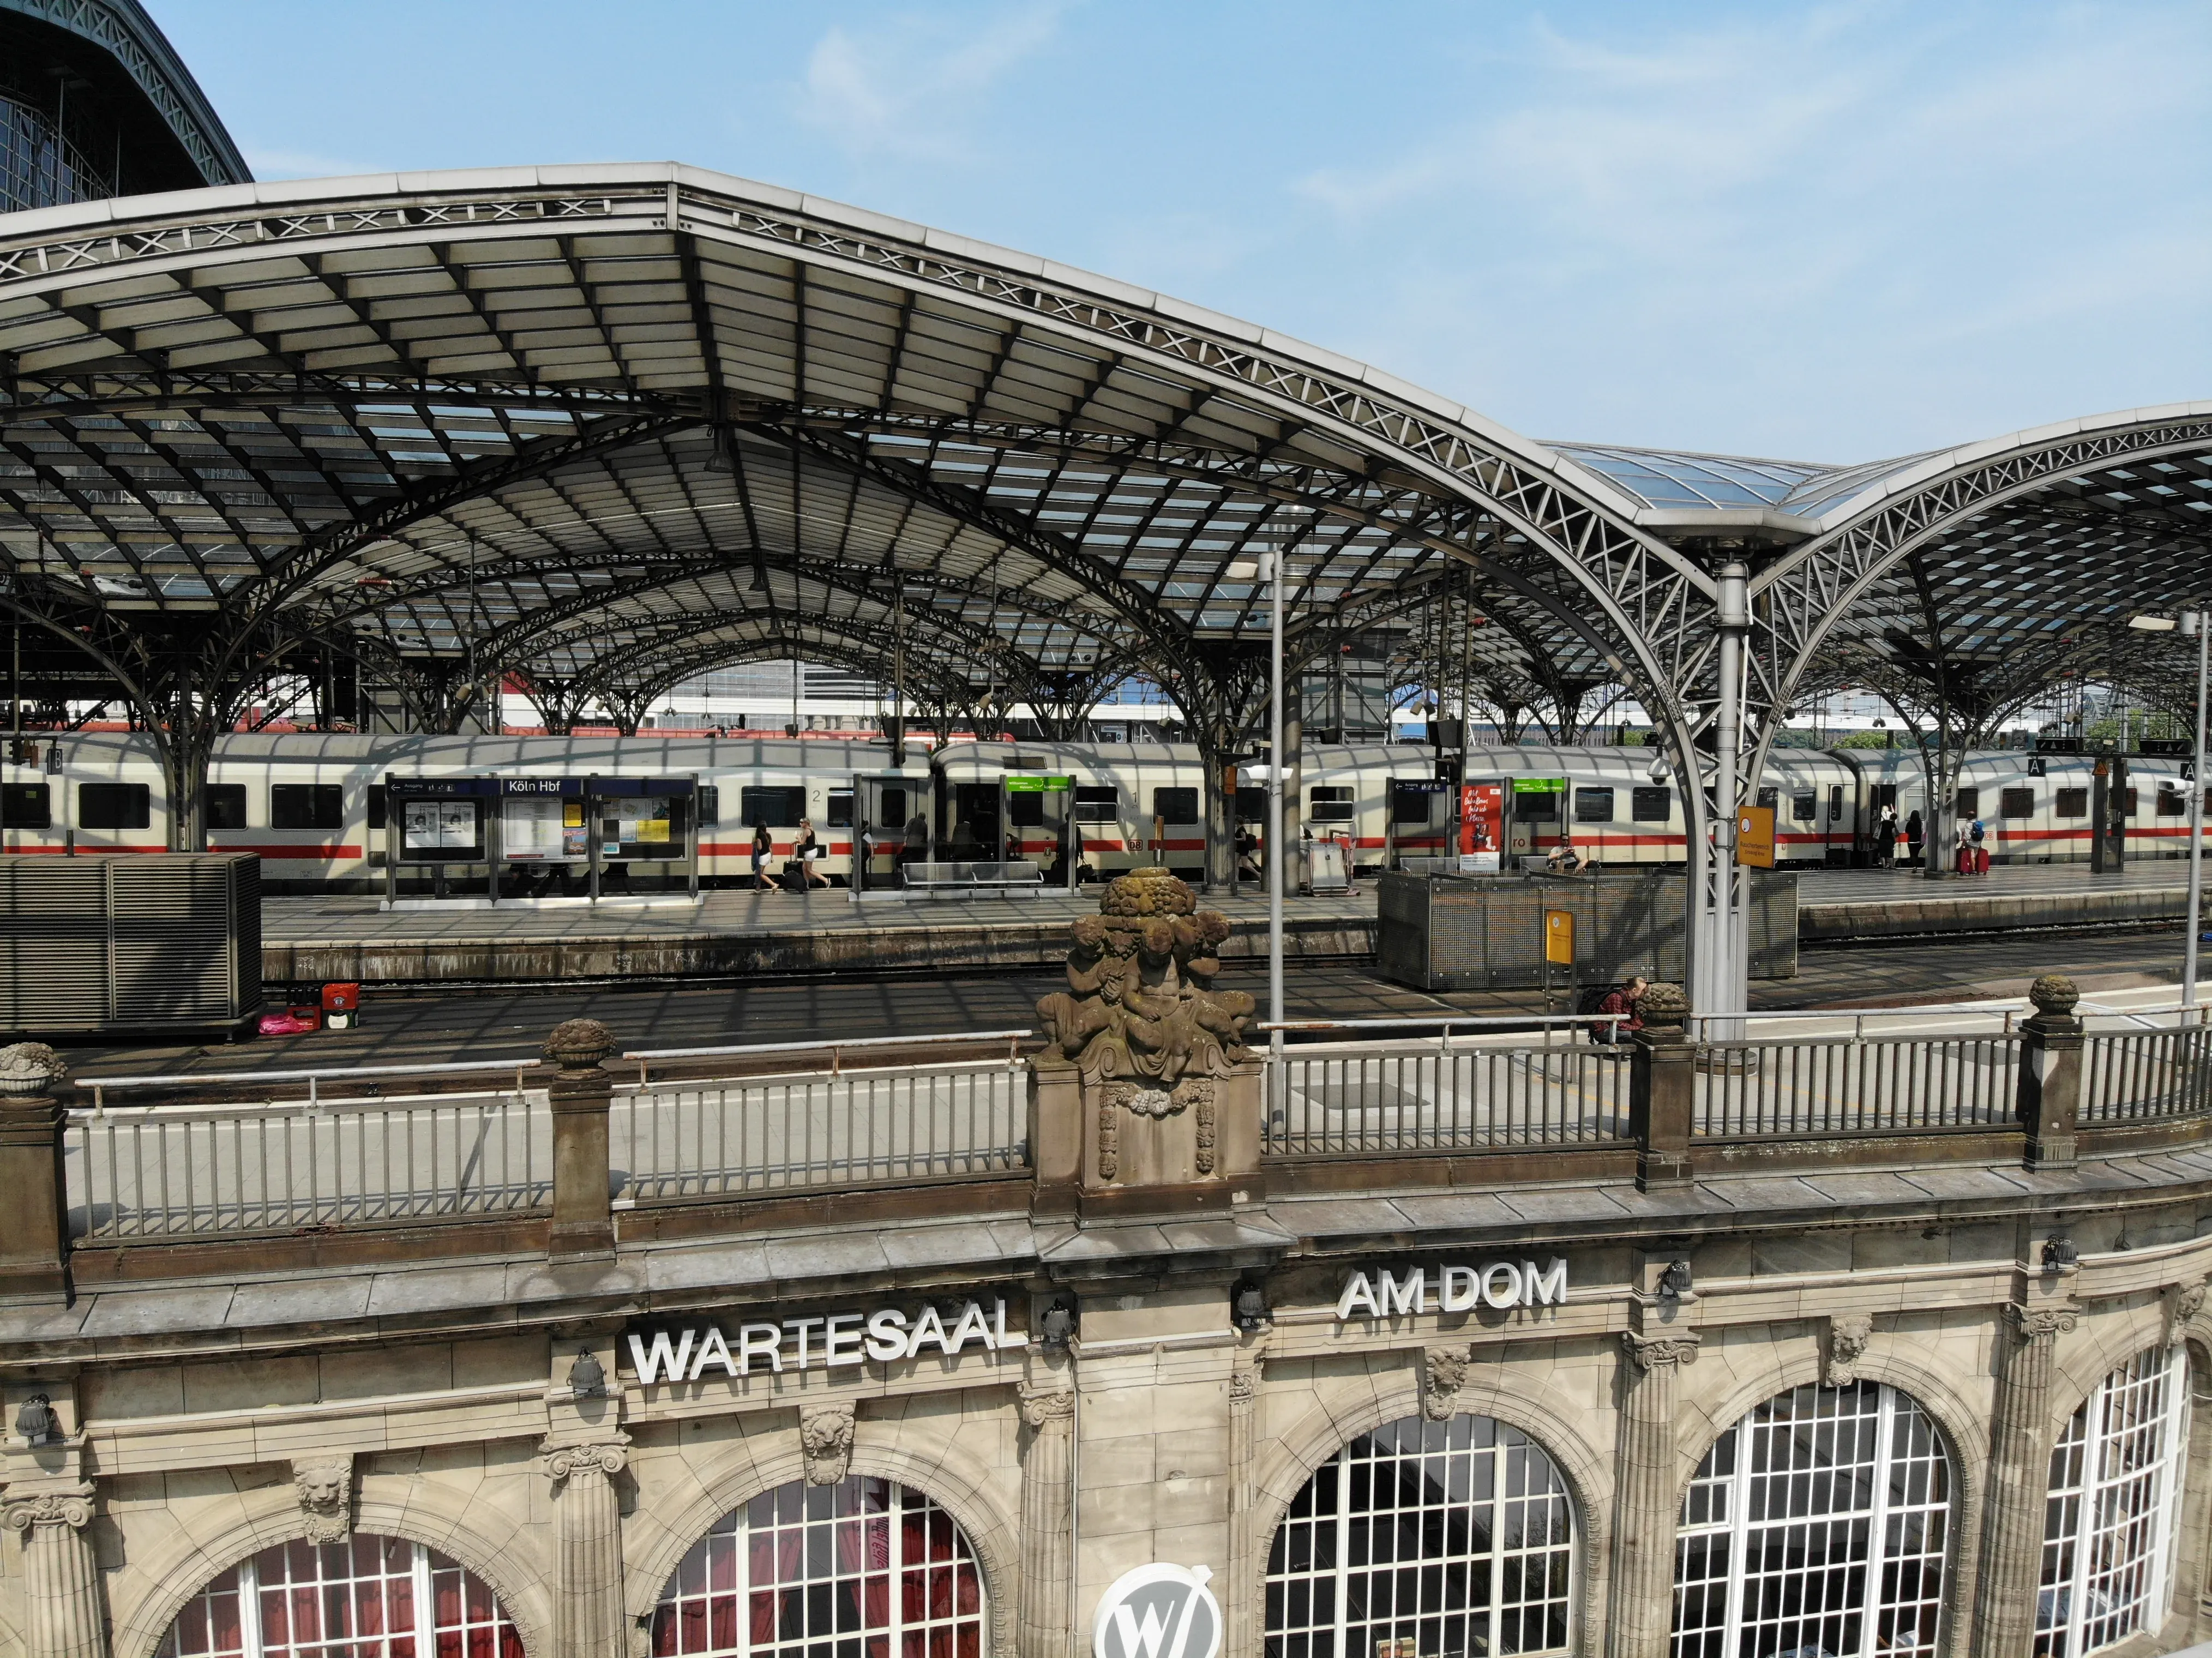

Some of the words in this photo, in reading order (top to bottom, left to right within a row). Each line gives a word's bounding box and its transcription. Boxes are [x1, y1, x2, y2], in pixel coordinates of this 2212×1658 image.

[56, 750, 61, 769] B
[2030, 760, 2040, 773] A
[2185, 764, 2195, 778] A
[509, 781, 535, 791] Köln
[540, 780, 561, 791] Hbf
[813, 790, 821, 802] 2
[1468, 789, 1478, 797] Mit
[1129, 840, 1142, 850] DB
[1336, 1264, 1424, 1319] AM
[1439, 1255, 1567, 1312] DOM
[628, 1295, 1029, 1384] WARTESAAL
